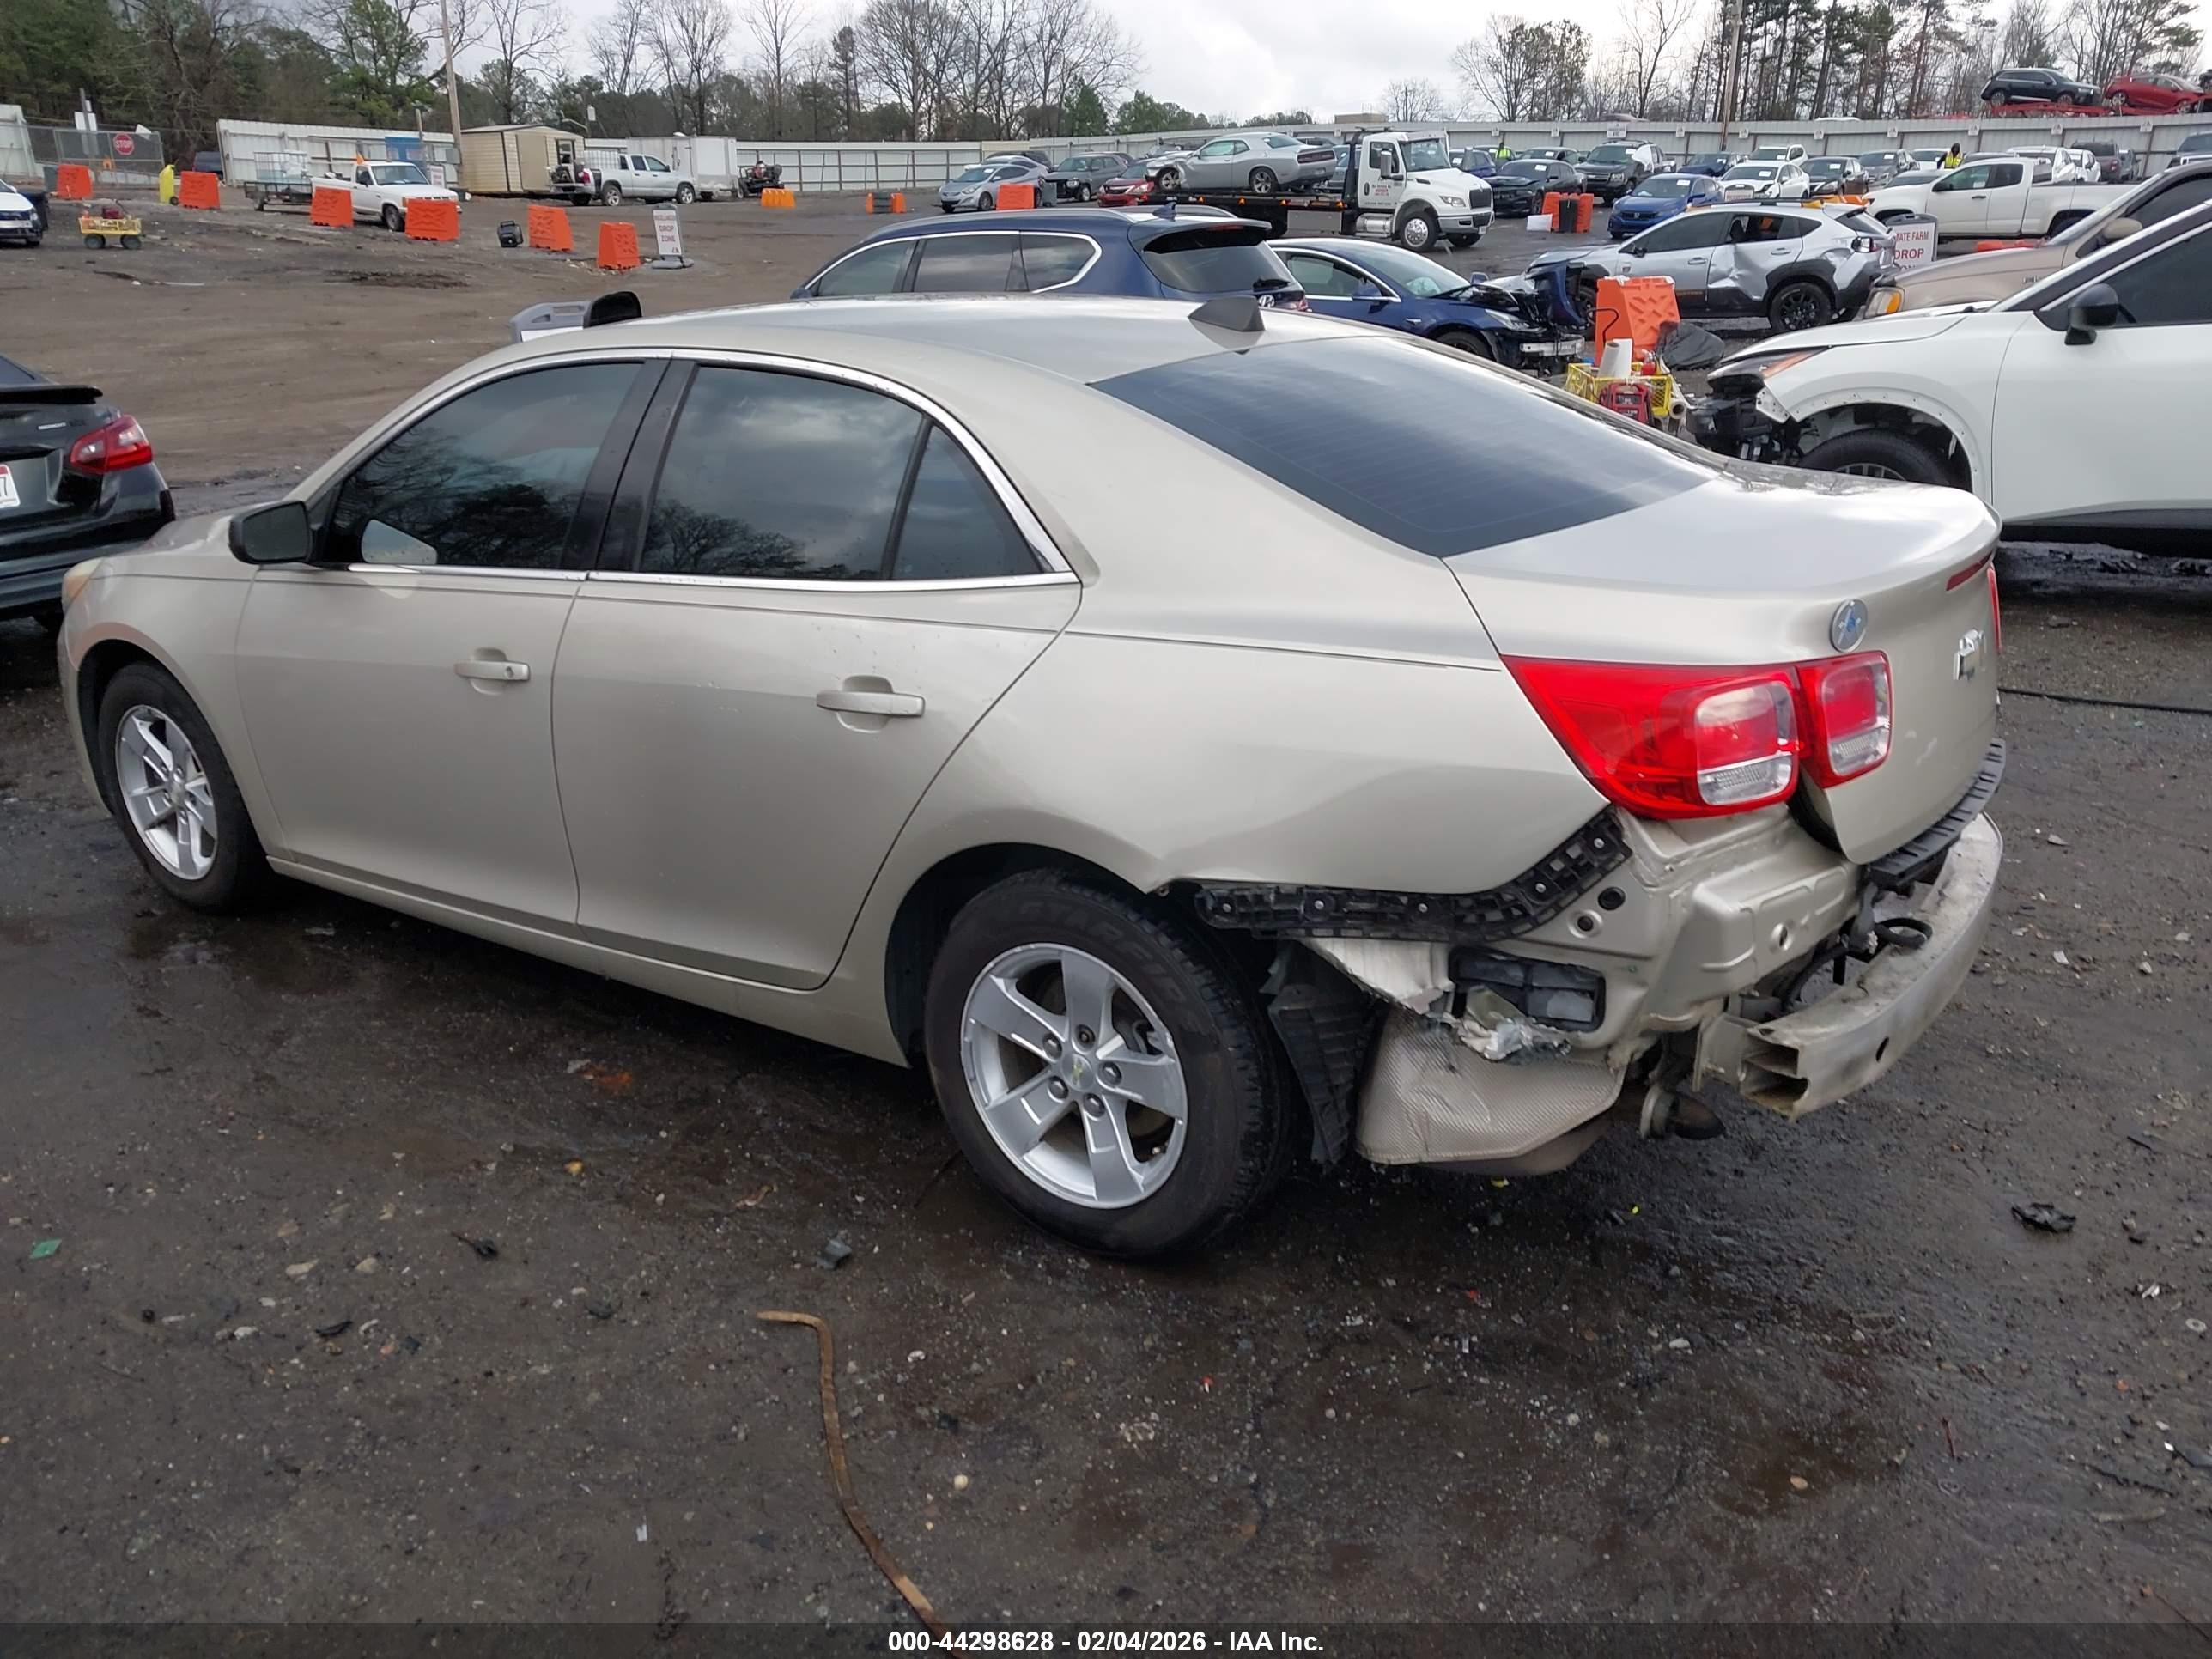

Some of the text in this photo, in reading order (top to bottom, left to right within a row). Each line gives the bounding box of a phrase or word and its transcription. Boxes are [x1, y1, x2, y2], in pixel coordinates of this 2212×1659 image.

[1896, 231, 1929, 241] TATE FARM
[1895, 248, 1924, 260] DROP
